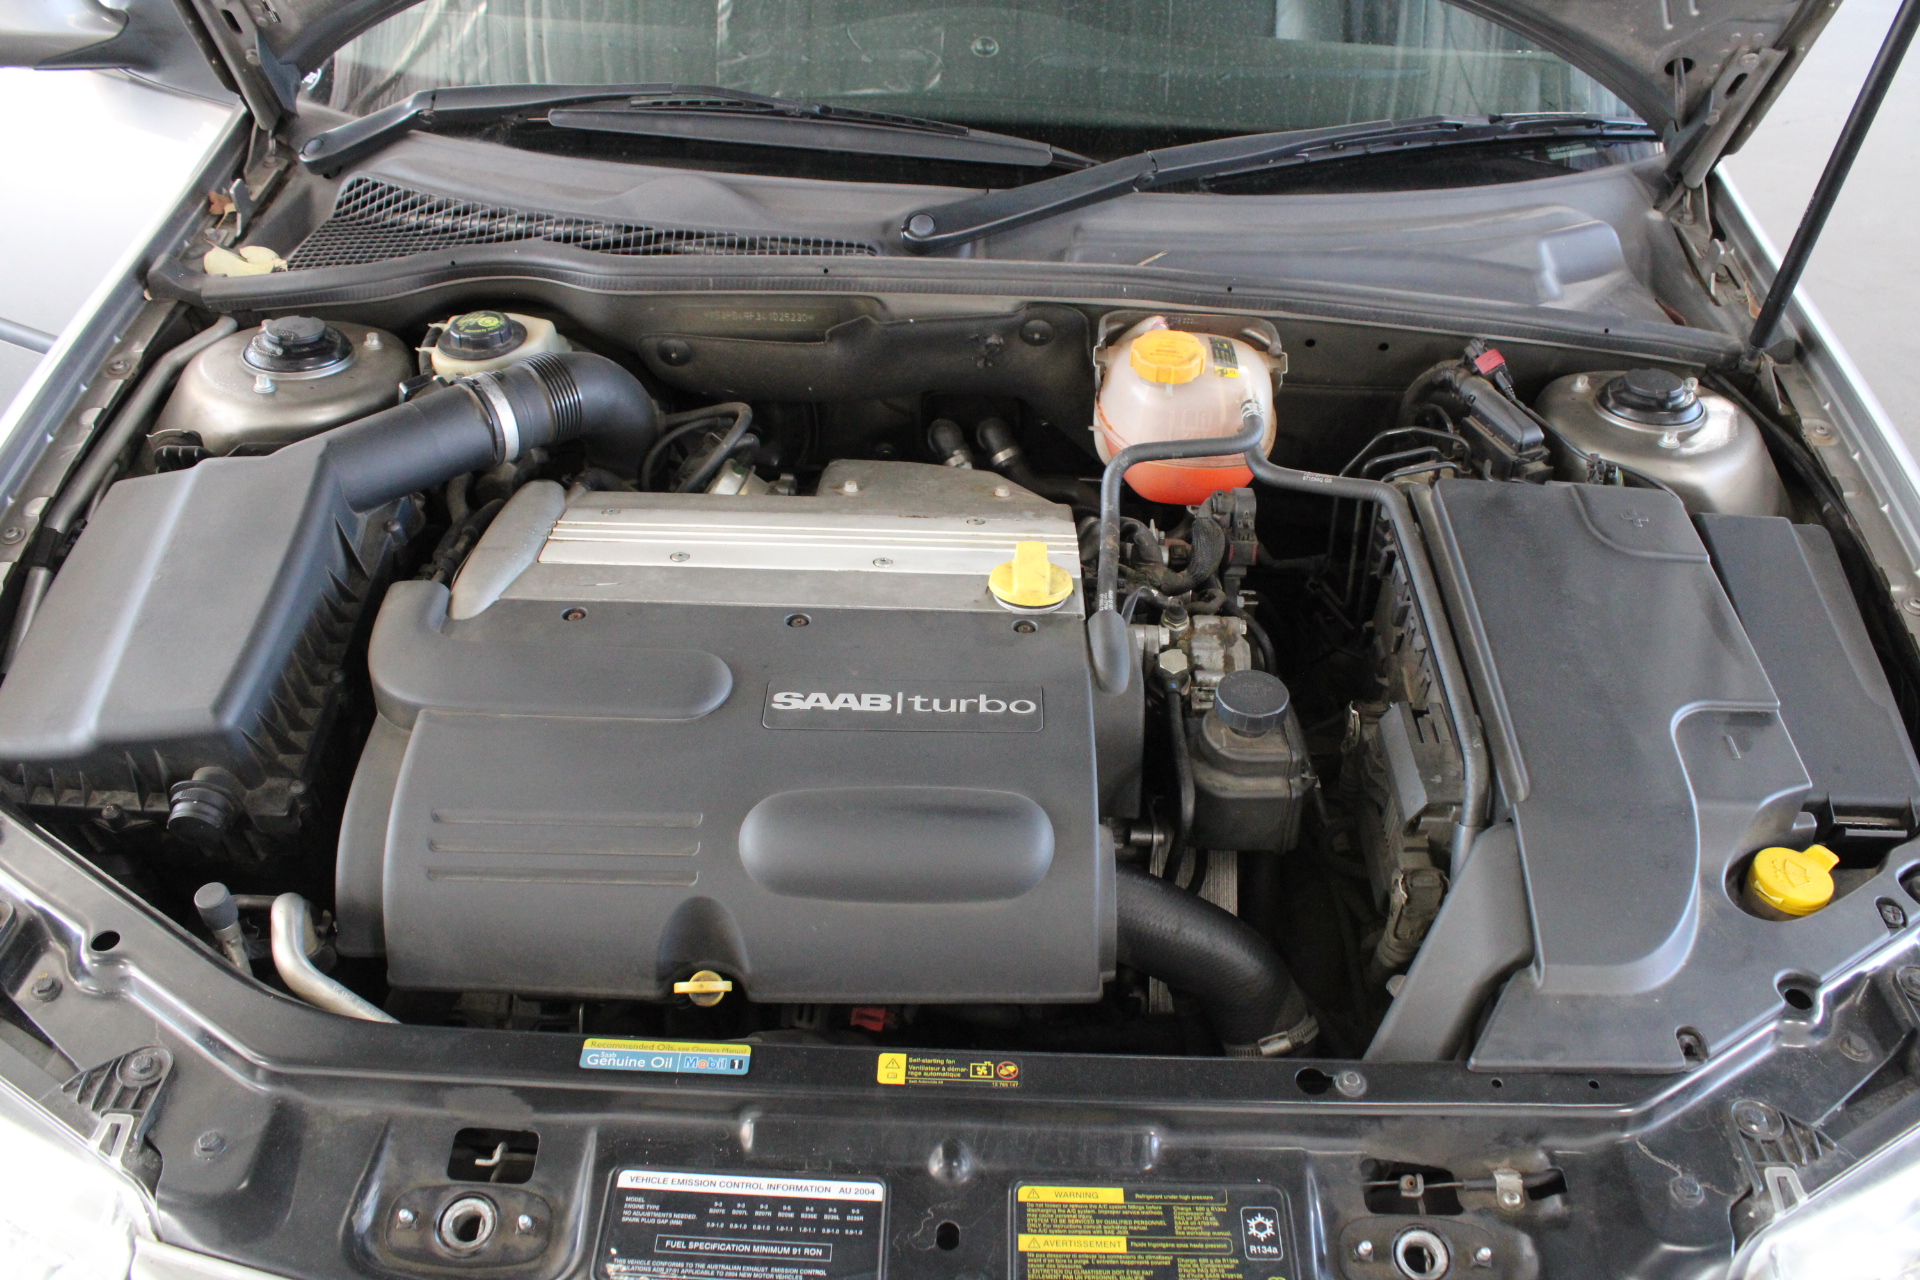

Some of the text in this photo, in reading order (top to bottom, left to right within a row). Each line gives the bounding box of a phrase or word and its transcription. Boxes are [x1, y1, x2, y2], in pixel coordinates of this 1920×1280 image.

[771, 692, 1037, 714] SAAB turbo
[590, 1041, 654, 1050] Recommended
[587, 1054, 646, 1068] Genuine
[651, 1056, 673, 1068] Oil
[684, 1057, 726, 1069] Mobil
[630, 1176, 669, 1184] VEHICLE
[670, 1178, 716, 1187] EMISSION
[719, 1181, 764, 1190] CONTROL
[766, 1183, 831, 1193] INFORMATION
[666, 1240, 686, 1249] FUEL
[688, 1241, 751, 1252] SPECIFICATION
[752, 1245, 790, 1255] MINIMUM
[804, 1248, 822, 1256] RON
[1044, 1240, 1122, 1248] AVERTISSEMENT
[1250, 1245, 1278, 1254] R134a
